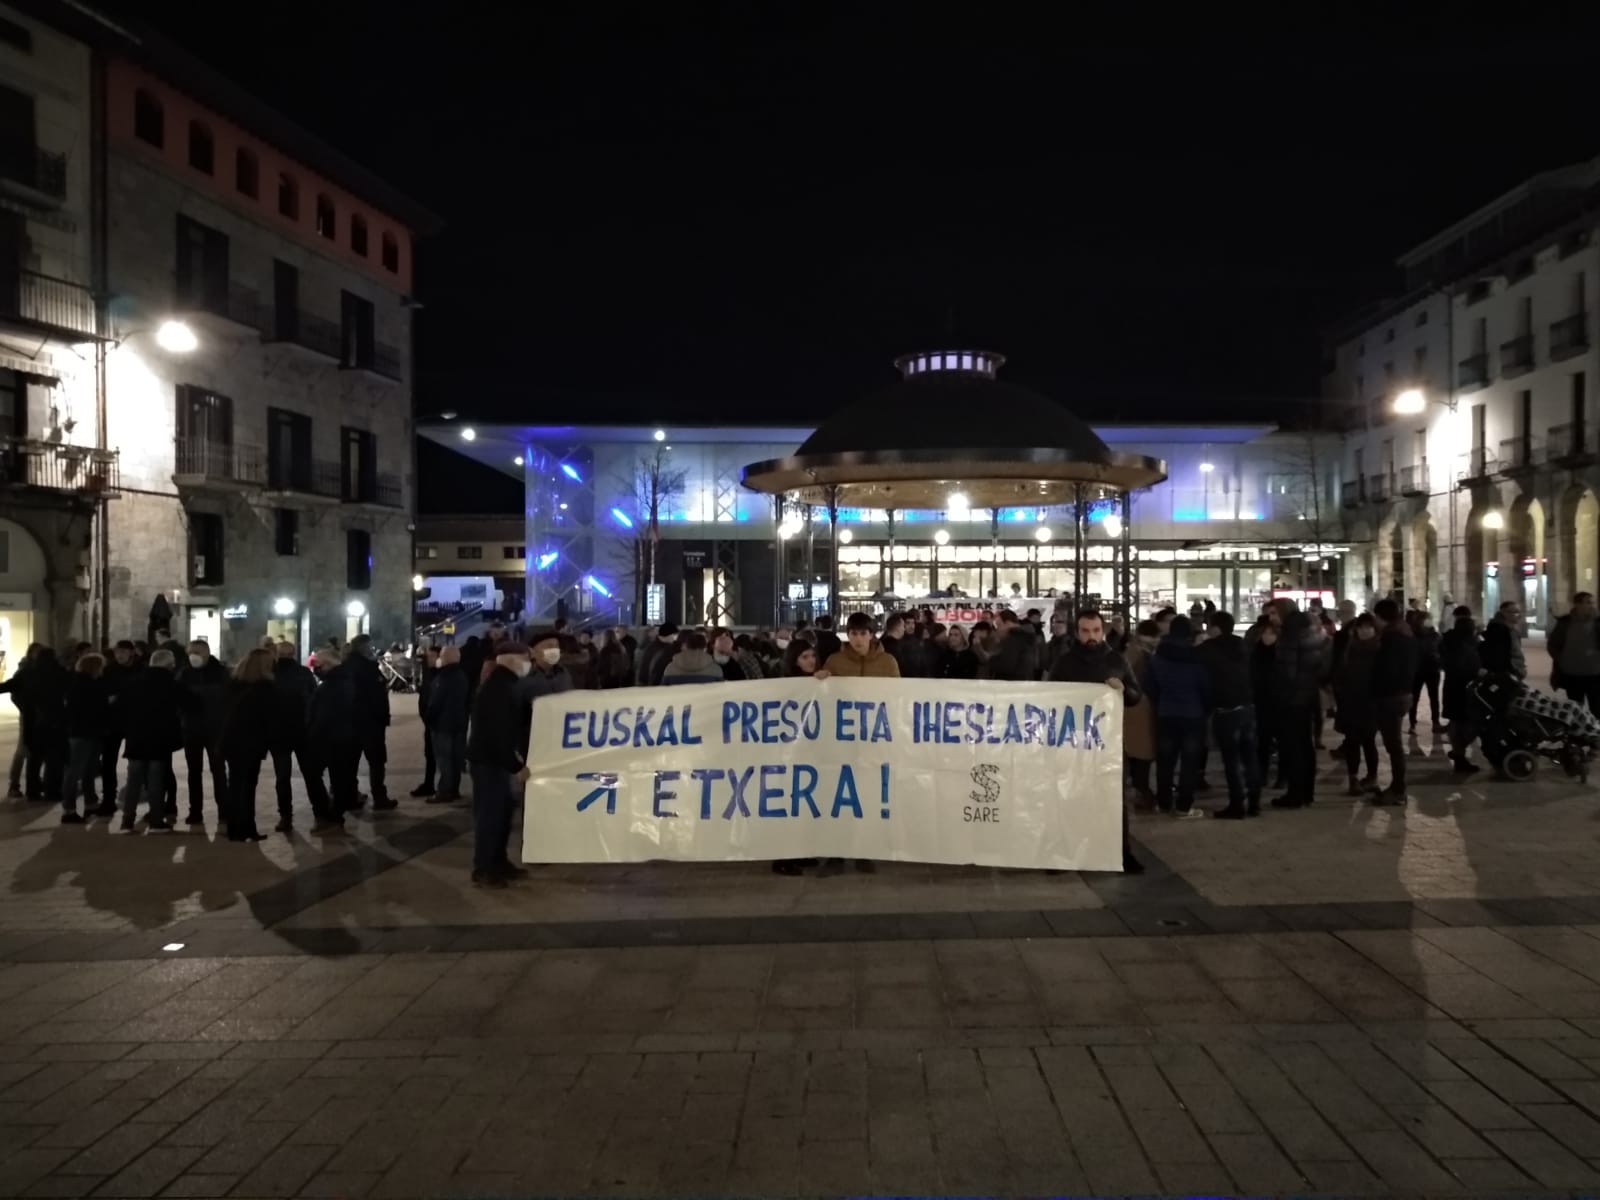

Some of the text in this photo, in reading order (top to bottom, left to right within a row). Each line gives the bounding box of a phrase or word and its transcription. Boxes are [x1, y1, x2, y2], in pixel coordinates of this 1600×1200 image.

[562, 699, 1106, 750] EUSKAL PRESO ETA IHESLARIAK
[963, 805, 1000, 823] SARE
